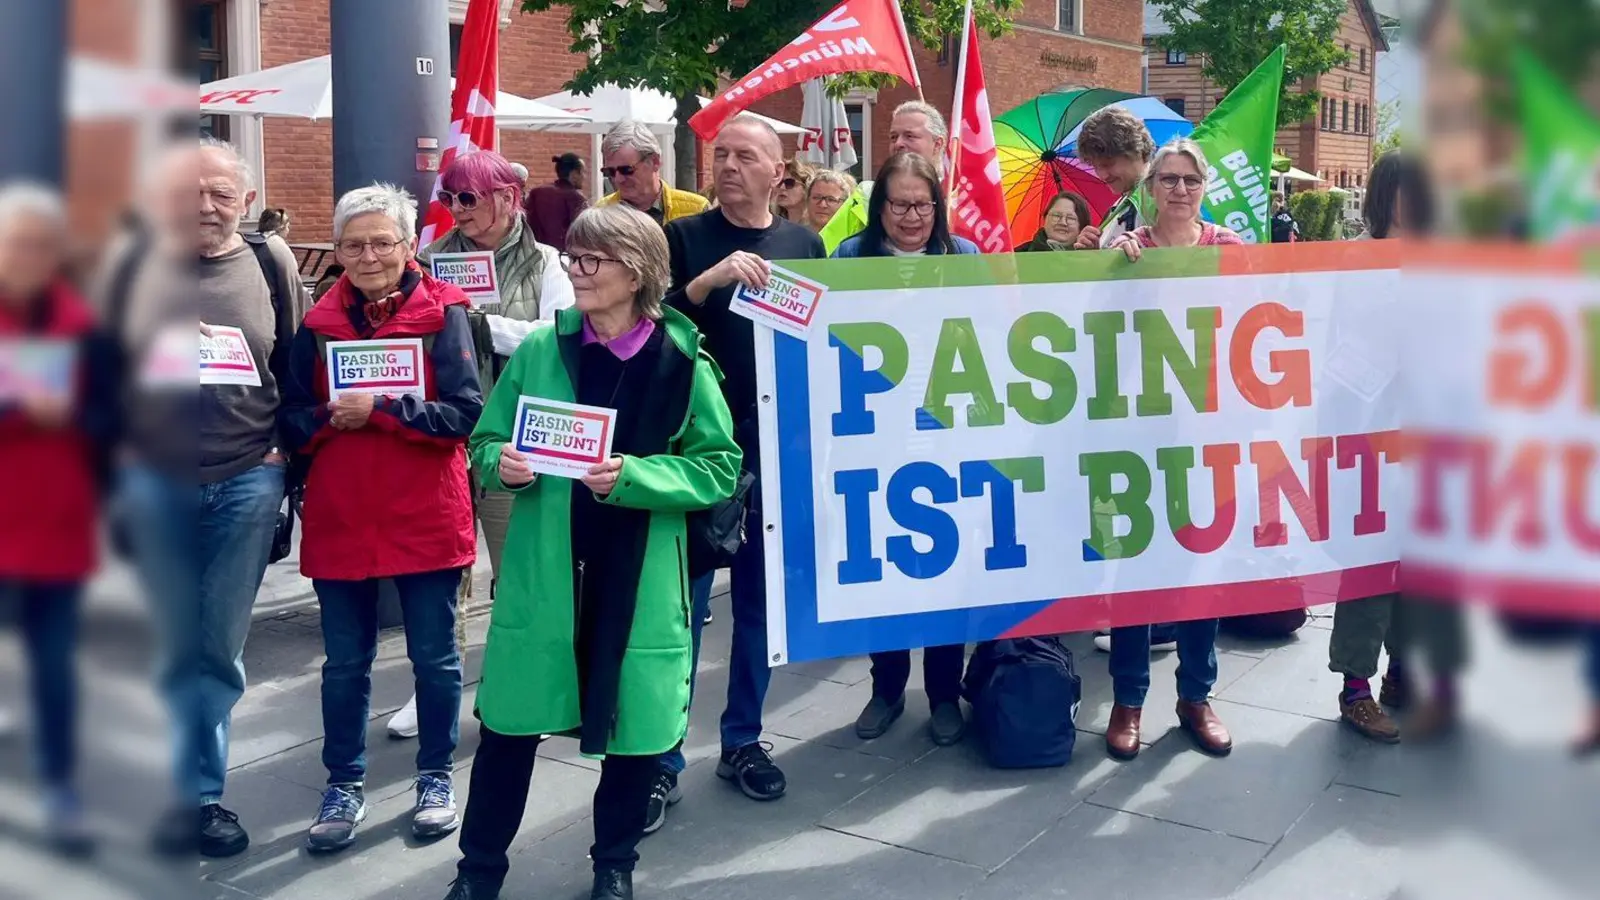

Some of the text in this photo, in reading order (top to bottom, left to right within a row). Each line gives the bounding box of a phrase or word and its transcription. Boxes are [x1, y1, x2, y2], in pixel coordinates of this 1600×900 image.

[418, 60, 433, 74] 10
[1220, 149, 1267, 232] BÜND
[951, 175, 1007, 251] ünch
[438, 264, 476, 275] PASING
[457, 274, 487, 285] BUNT
[766, 278, 801, 299] SING
[771, 293, 808, 314] BUNT
[200, 349, 215, 360] ST
[340, 353, 397, 366] PASING
[341, 366, 411, 379] IST BUNT
[828, 302, 1312, 437] PASING
[527, 413, 584, 434] PASING
[525, 428, 597, 451] IST BUNT
[833, 430, 1400, 585] IST BUNT
